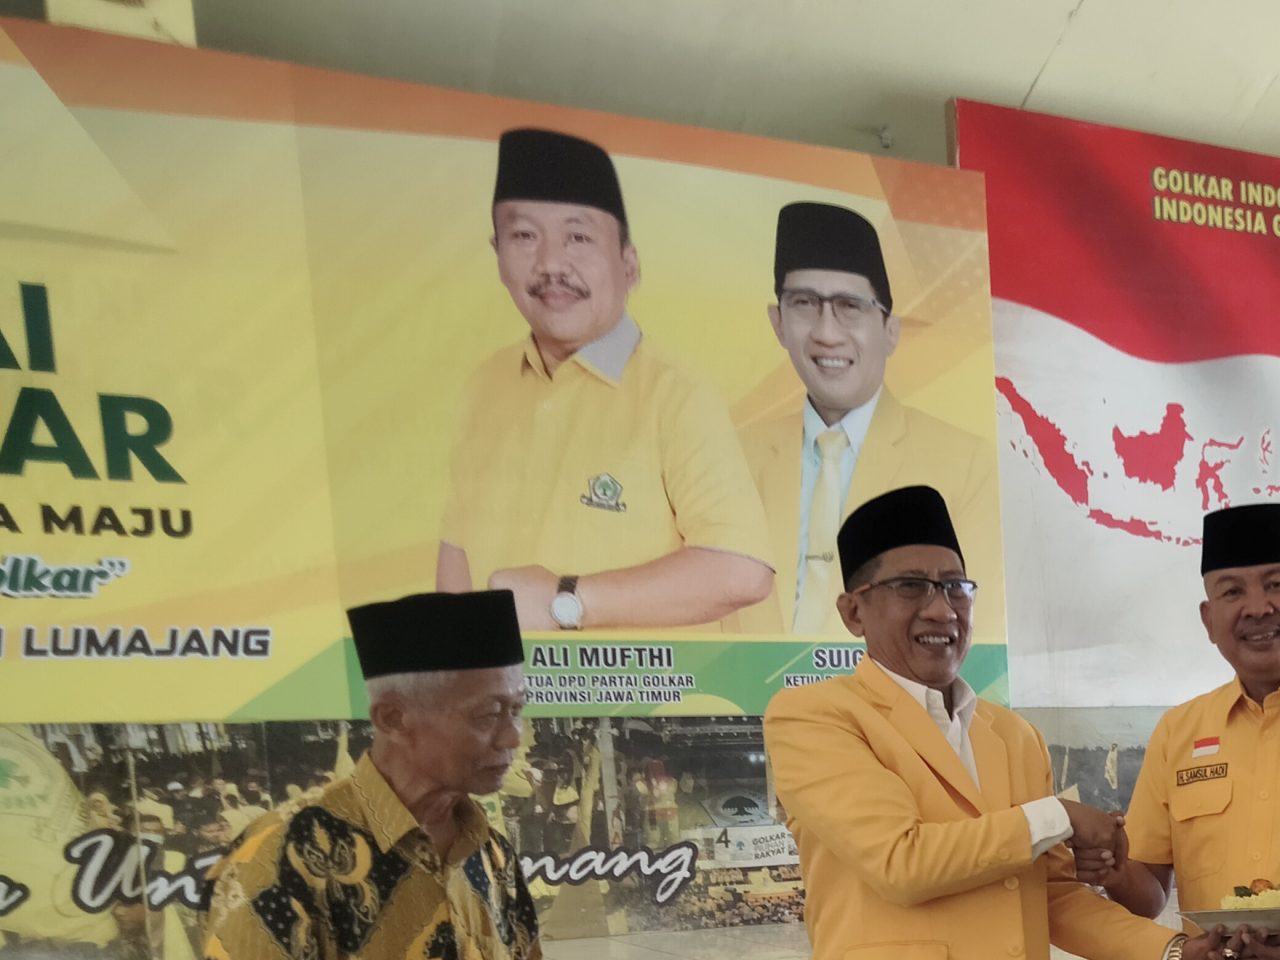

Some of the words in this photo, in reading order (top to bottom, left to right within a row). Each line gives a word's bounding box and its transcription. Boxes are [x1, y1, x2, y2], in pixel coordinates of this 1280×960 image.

[1153, 166, 1233, 201] GOLKAR
[1154, 196, 1267, 235] INDONESIA
[40, 503, 193, 538] MAJU
[24, 627, 270, 657] LUMAJANG
[532, 647, 569, 667] ALI
[579, 647, 673, 667] MUFTHI
[526, 675, 552, 687] TUA
[559, 675, 586, 687] DPD
[591, 675, 637, 687] PARTAI
[643, 675, 694, 688] GOLKAR
[526, 691, 591, 702] PROVINSI
[596, 691, 633, 702] JAWA
[638, 691, 681, 702] TIMUR
[716, 828, 731, 848] 4
[520, 846, 693, 903] nang
